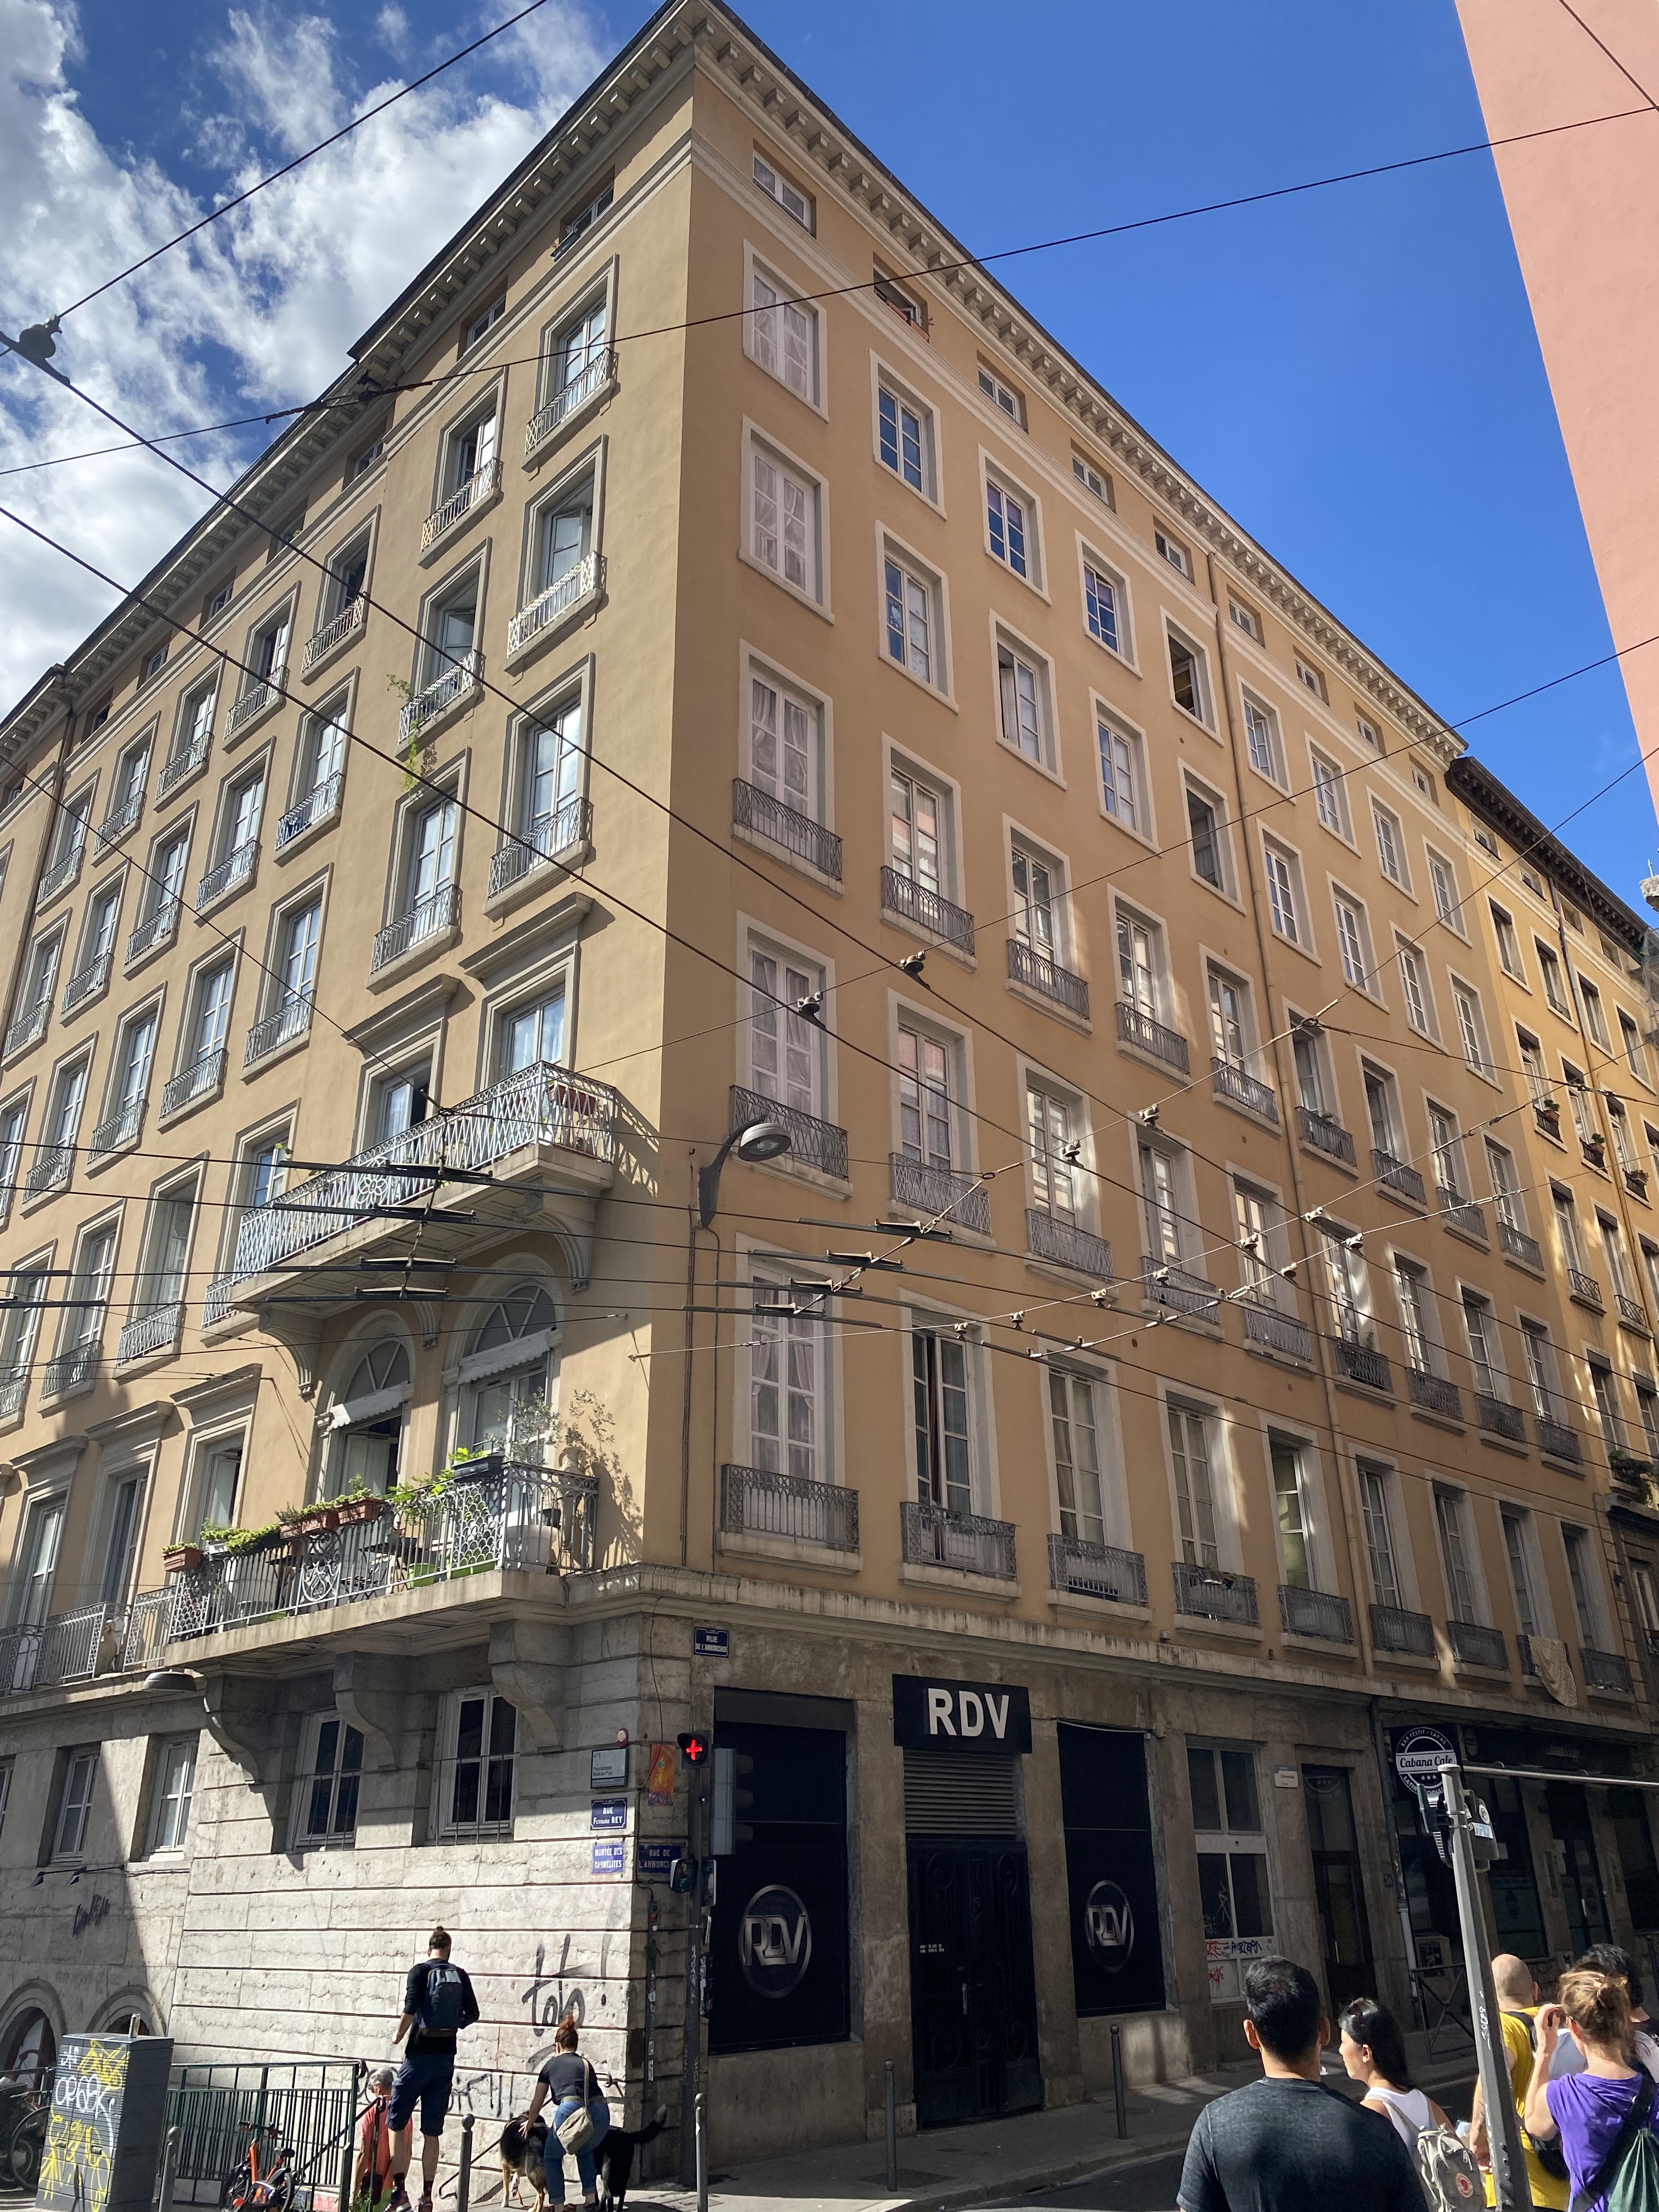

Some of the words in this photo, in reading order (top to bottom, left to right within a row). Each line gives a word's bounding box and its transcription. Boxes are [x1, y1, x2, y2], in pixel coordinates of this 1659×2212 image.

[928, 1688, 1009, 1739] RDV
[1430, 1731, 1447, 1745] TAPAS
[1400, 1758, 1432, 1768] Cabana
[595, 1846, 612, 1857] MONTÉE
[613, 1847, 623, 1855] DES
[594, 1858, 622, 1869] CARMÉLITES
[639, 1860, 671, 1869] L'ANNONCI
[1088, 1905, 1128, 1946] RDV
[743, 1914, 805, 1966] RDV
